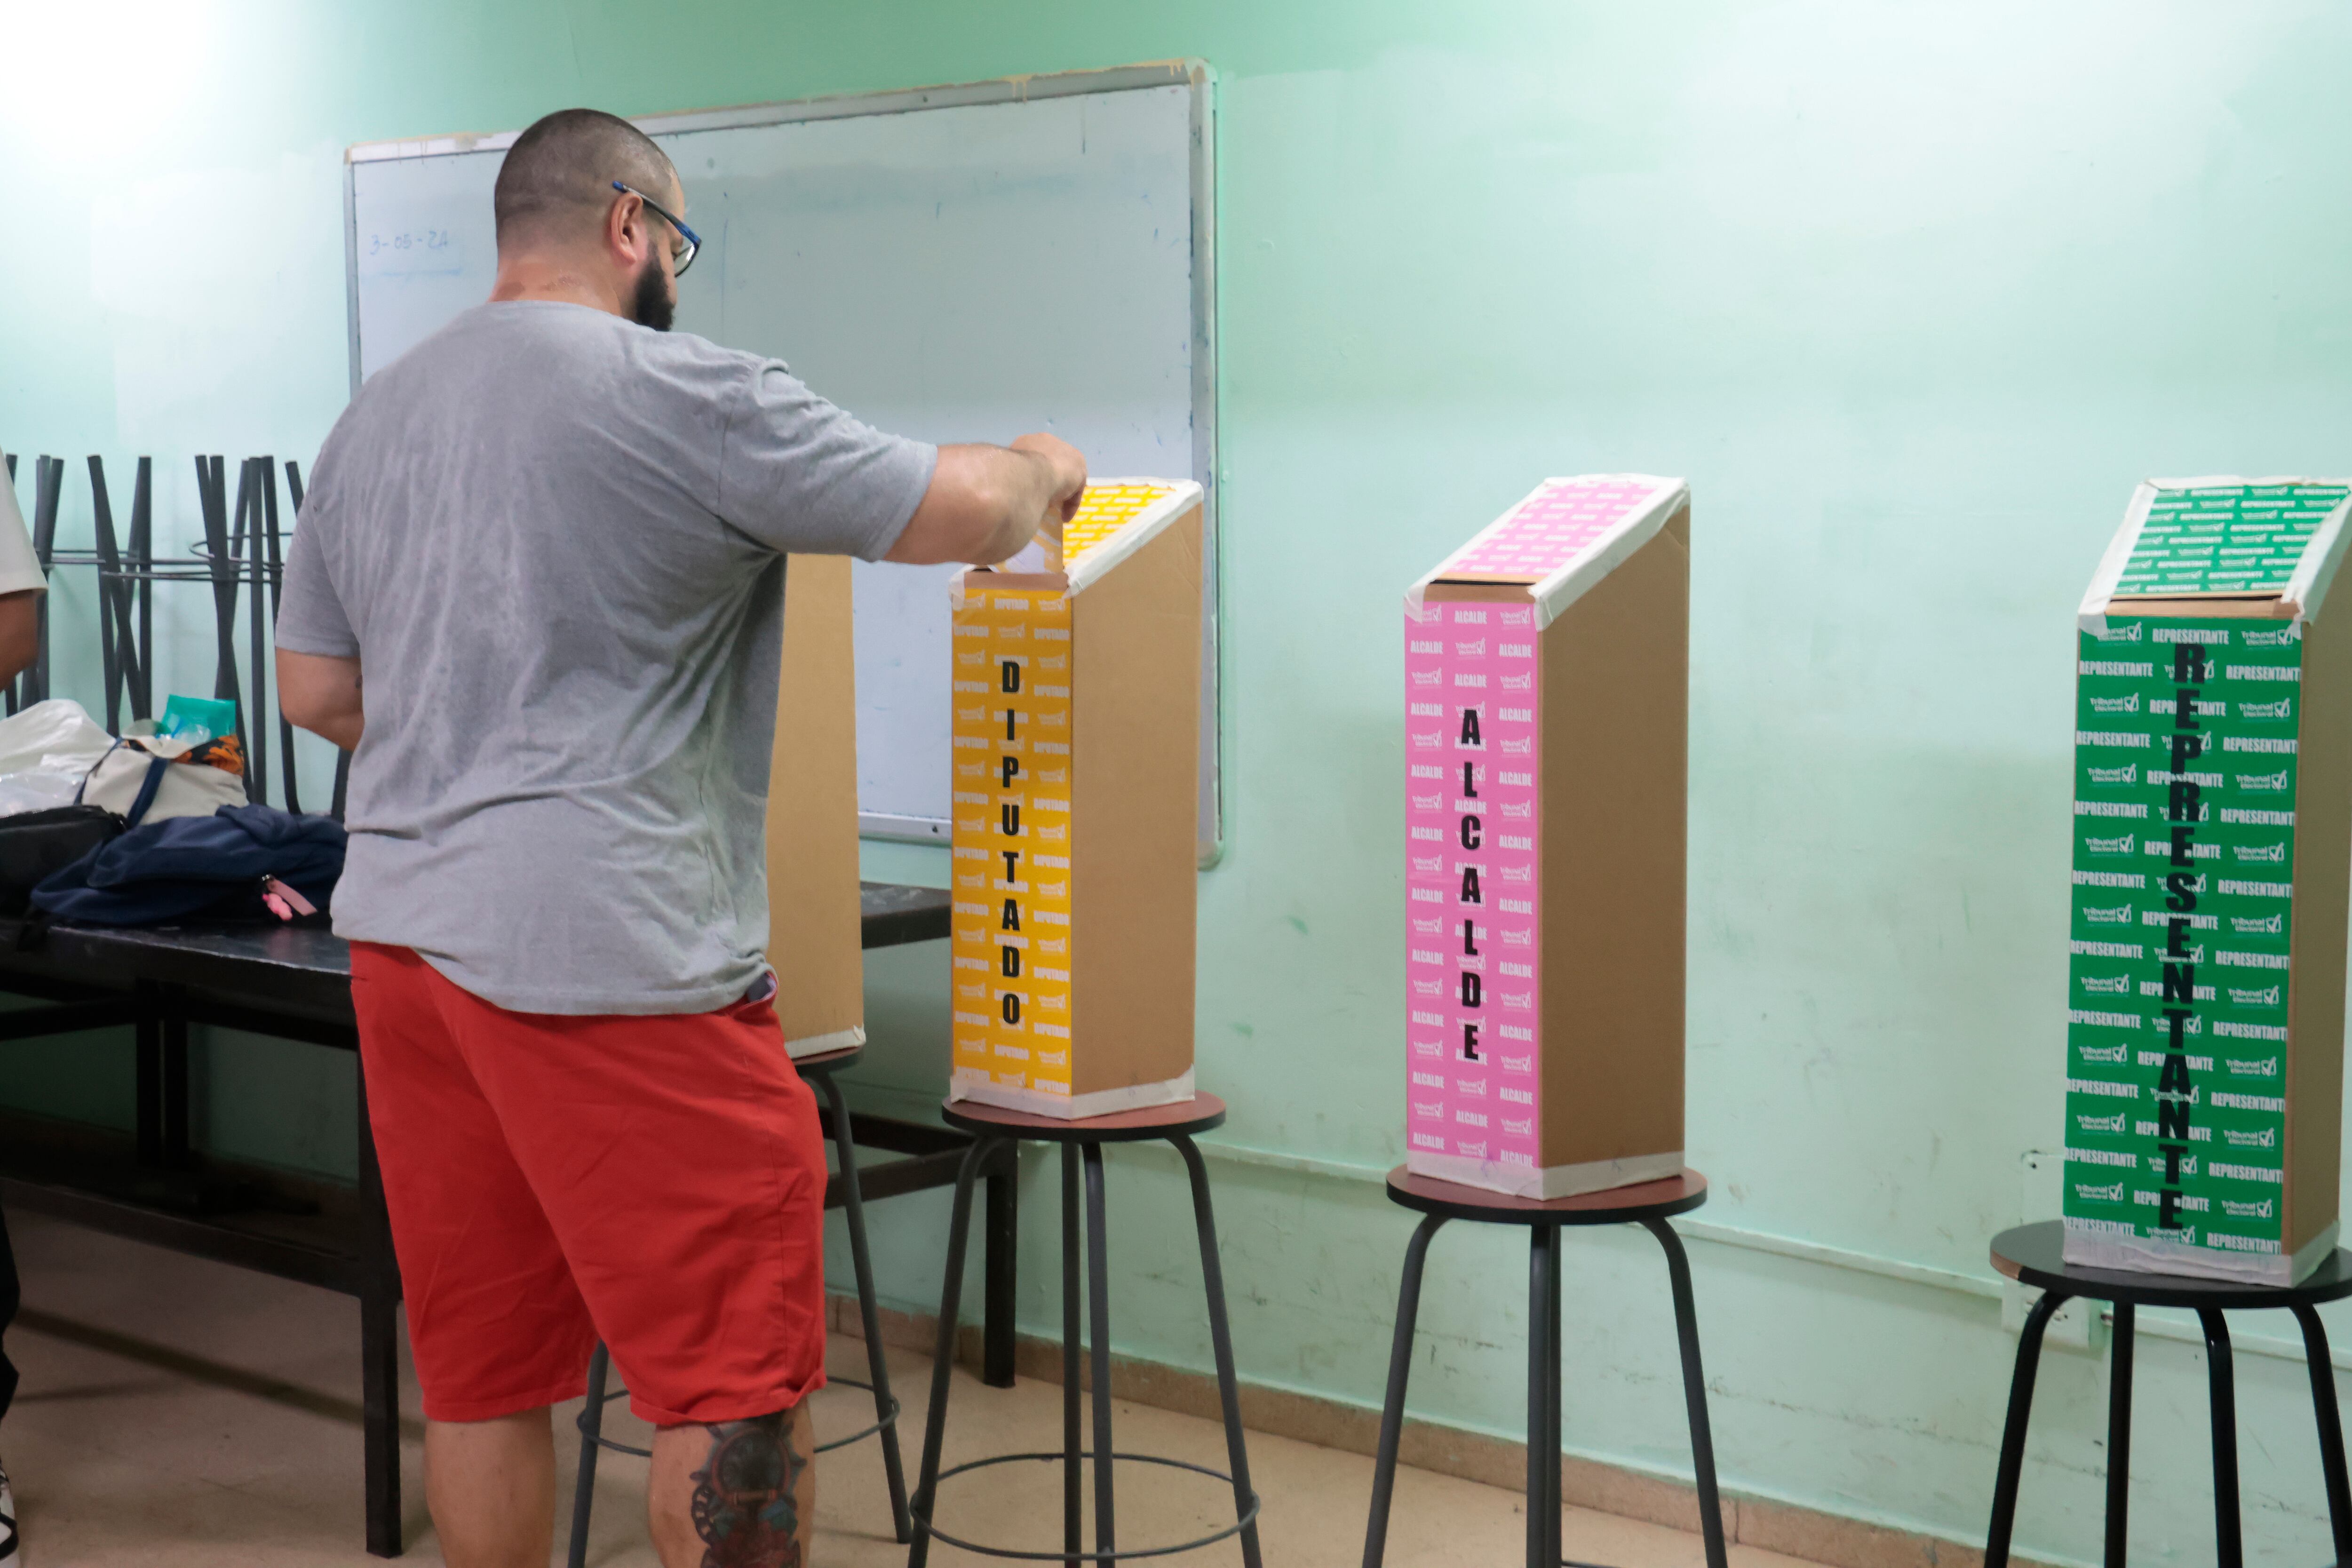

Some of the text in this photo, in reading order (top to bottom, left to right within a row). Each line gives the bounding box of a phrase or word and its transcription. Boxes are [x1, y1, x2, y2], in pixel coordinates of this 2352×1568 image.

[1454, 610, 1487, 625] ALCALDE
[2153, 629, 2229, 645] REPRESENTANTE
[1410, 640, 1443, 655] ALCALDE
[1499, 644, 1532, 658] ALCALDE
[1454, 673, 1487, 688] ALCALDE
[2226, 665, 2301, 682] REPRESENTANT
[1410, 702, 1443, 717] ALCALDE
[1499, 708, 1532, 723] ALCALDE
[2150, 700, 2225, 716] REPRTANTE
[2223, 737, 2298, 754] REPRESENTANT
[1411, 764, 1443, 780] ALCALDE
[1499, 771, 1532, 787] ALCALDE
[2087, 768, 2121, 776] Tribunal
[1454, 799, 1487, 814] ALCALDE
[2220, 808, 2295, 826] REPRESENTANT
[1411, 826, 1443, 842] ALCALDE
[2085, 837, 2118, 846] Tribunal
[1002, 661, 1020, 1024] DIPUTADO
[1499, 835, 1532, 851] ALCALDE
[2145, 841, 2220, 859] REPRTANTE
[2233, 846, 2267, 855] Tribunal
[1461, 709, 1481, 1060] ALCALDE
[2218, 879, 2292, 898] REPRESENTANT
[1412, 888, 1443, 903] ALCALDE
[1499, 898, 1532, 915] ALCALDE
[2082, 907, 2116, 916] Tribunal
[2231, 917, 2265, 926] Tribunal
[2158, 643, 2206, 1229] REPRESENTANTE
[1412, 949, 1444, 965] ALCALDE
[2216, 950, 2290, 970] REPRESENTANT
[1499, 961, 1532, 978] ALCALDE
[2081, 977, 2114, 986] Tribunal
[2228, 988, 2262, 997] Tribunal
[1412, 1010, 1444, 1027] ALCALDE
[1500, 1024, 1532, 1042] ALCALDE
[2213, 1021, 2287, 1041] REPRESENTANT
[2079, 1046, 2112, 1055] Tribunal
[2225, 1059, 2260, 1068] Tribunal
[1413, 1071, 1444, 1089] ALCALDE
[1500, 1087, 1533, 1105] ALCALDE
[2211, 1091, 2285, 1113] REPRESENTANT
[1456, 1110, 1487, 1128] ALCALDE
[2076, 1115, 2109, 1124] Tribunal
[1413, 1132, 1445, 1150] ALCALDE
[2224, 1129, 2258, 1139] Tribunal
[2209, 1162, 2283, 1184] REPRESENTANT
[2075, 1184, 2108, 1194] Tribunal
[2222, 1200, 2256, 1210] Tribunal
[2207, 1232, 2281, 1255] REPRESENTANT
